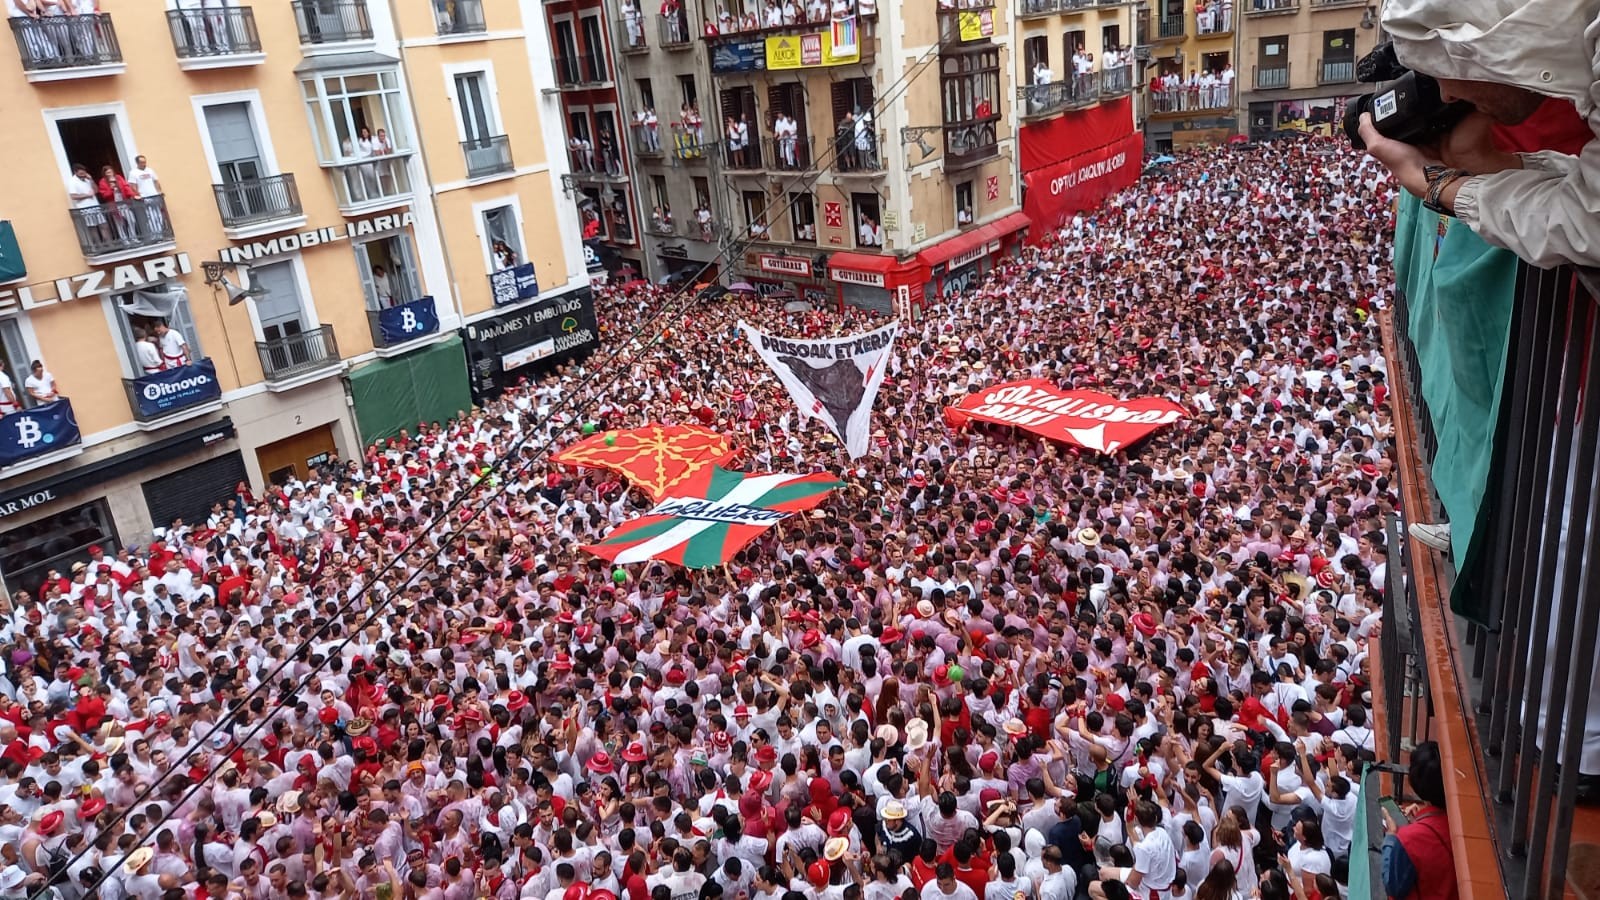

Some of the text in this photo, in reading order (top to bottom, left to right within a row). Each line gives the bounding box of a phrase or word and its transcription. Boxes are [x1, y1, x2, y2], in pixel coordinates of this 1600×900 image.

[220, 212, 416, 263] INMOBILIARIA
[768, 259, 802, 271] GUTIERREZ
[838, 270, 878, 284] GUTIERREZ
[479, 299, 582, 342] JAMONES Y EMBUTIDOS
[760, 335, 833, 360] PRESOAK
[983, 384, 1184, 425] SOZIALISMOA
[294, 415, 302, 425] 2
[21, 489, 56, 509] MOL
